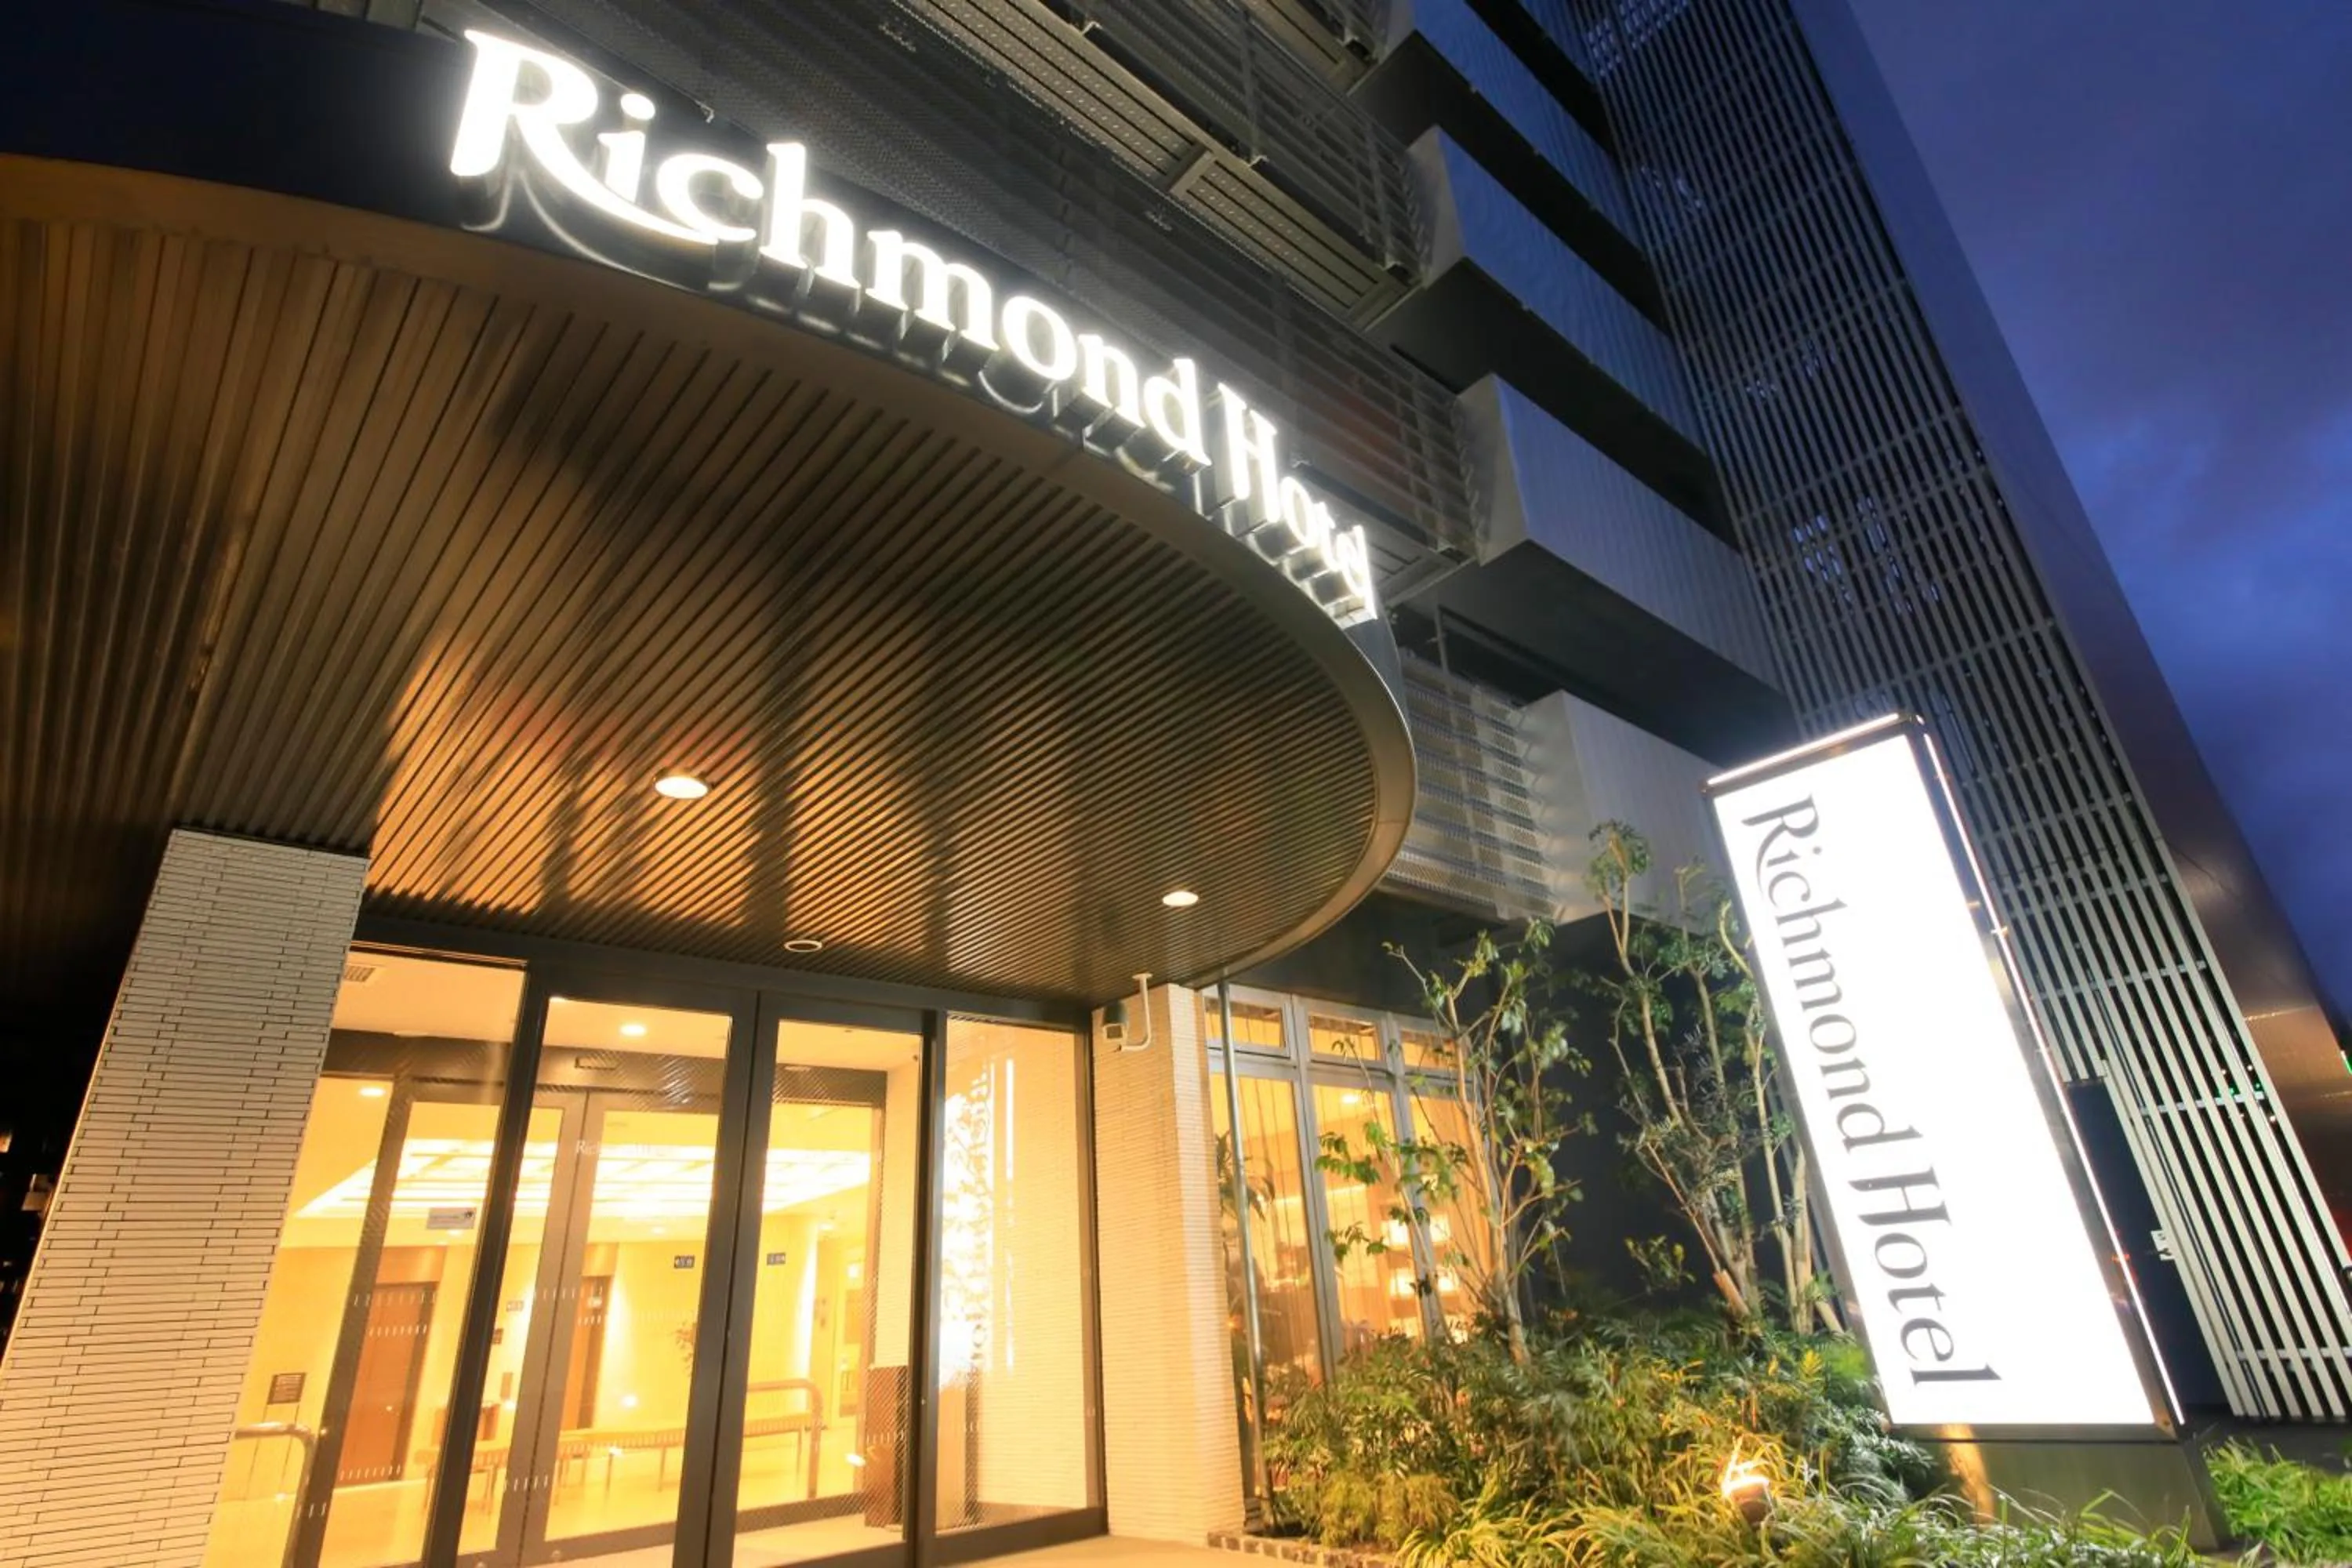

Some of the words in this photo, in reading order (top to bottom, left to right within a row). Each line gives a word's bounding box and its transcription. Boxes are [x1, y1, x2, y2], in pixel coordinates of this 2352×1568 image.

[450, 28, 1213, 467] Richmond
[1218, 382, 1378, 619] Hotel
[1740, 792, 1923, 1152] Richmond
[1847, 1164, 2002, 1386] Hotel
